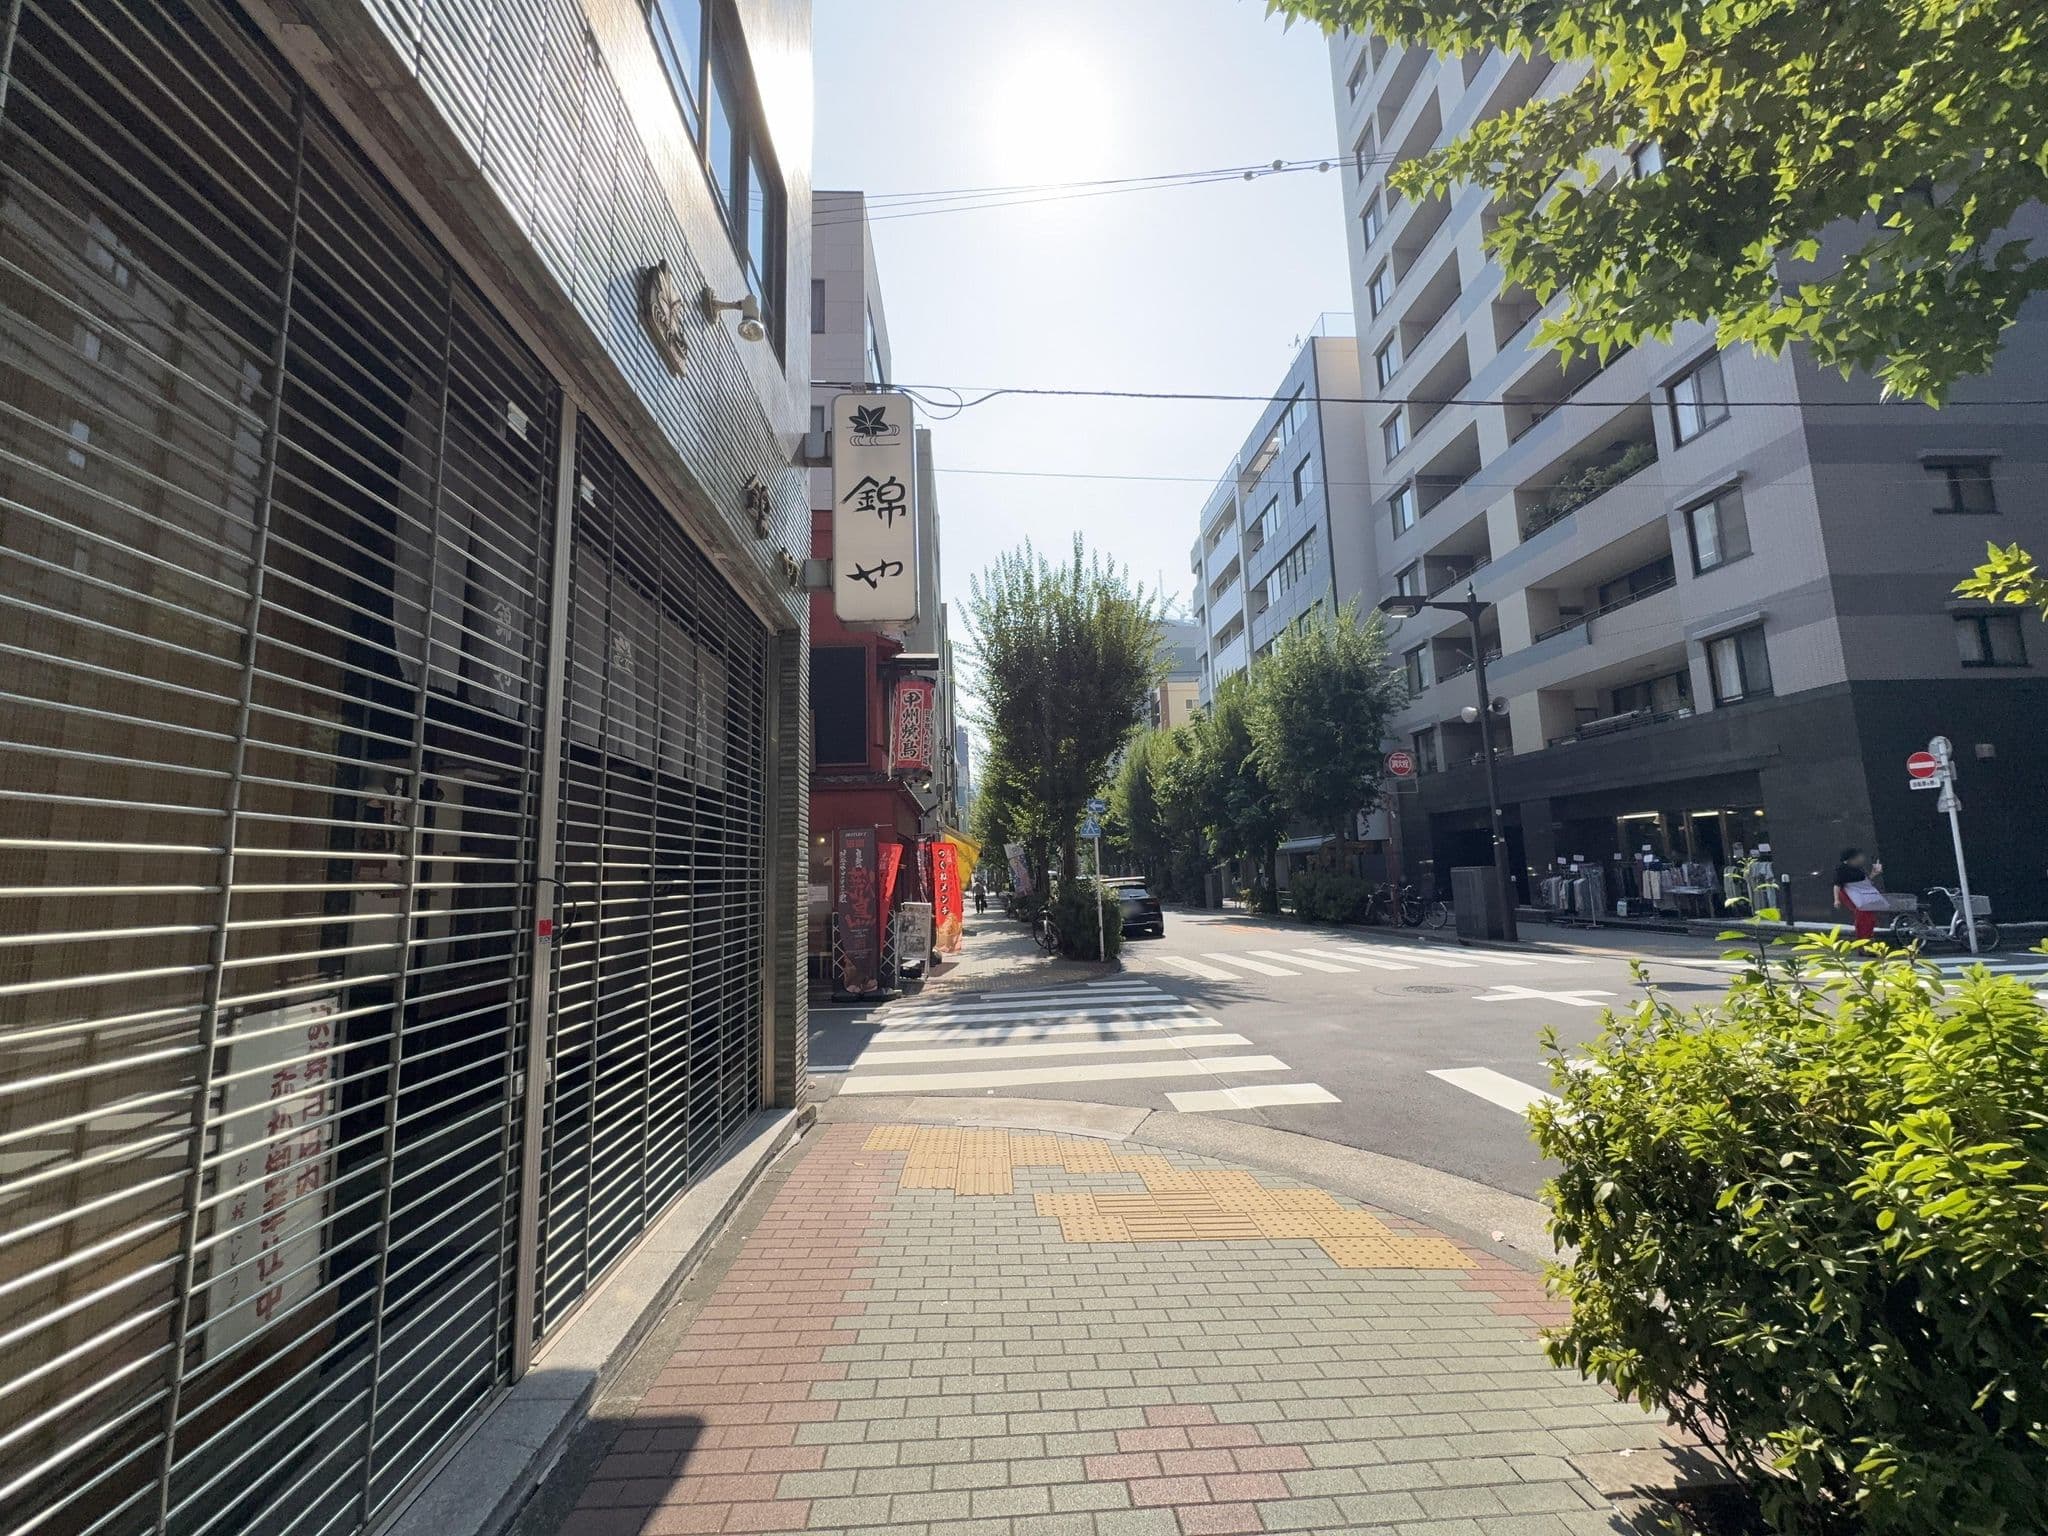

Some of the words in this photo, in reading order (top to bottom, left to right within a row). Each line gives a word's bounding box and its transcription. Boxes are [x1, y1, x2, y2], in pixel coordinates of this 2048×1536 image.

[839, 475, 906, 589] 錦や
[900, 691, 921, 758] 甲州焼鳥
[938, 849, 949, 915] つくねメンチ
